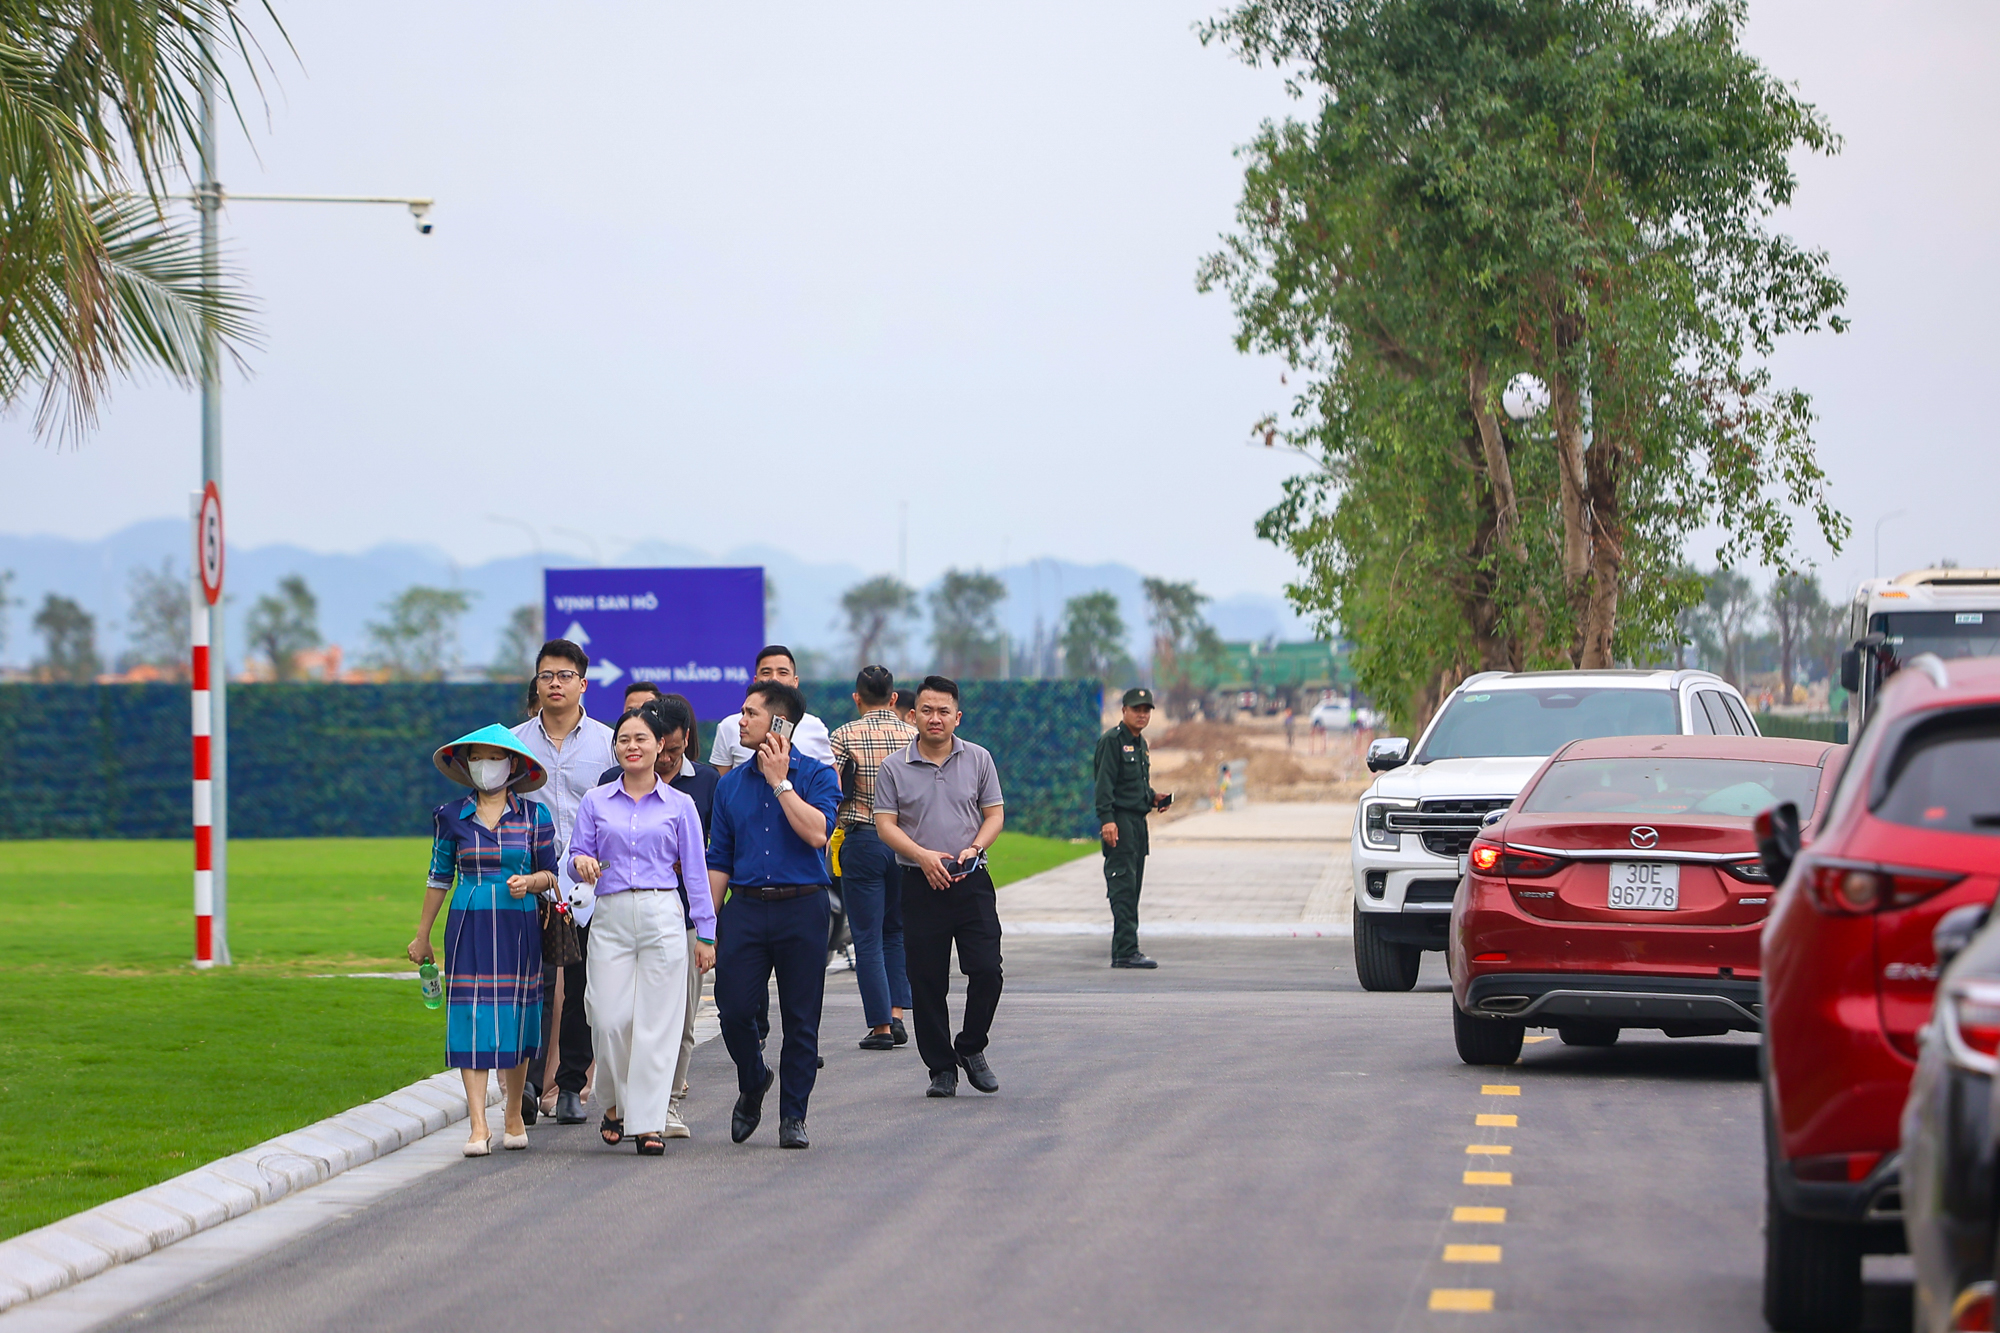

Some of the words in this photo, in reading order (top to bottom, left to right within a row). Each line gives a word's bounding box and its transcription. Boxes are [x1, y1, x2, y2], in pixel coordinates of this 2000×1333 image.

[208, 516, 217, 571] 5
[553, 595, 594, 614] VỊNH
[596, 595, 629, 611] SAN
[1627, 864, 1662, 884] 30E
[1612, 886, 1674, 906] 967.78
